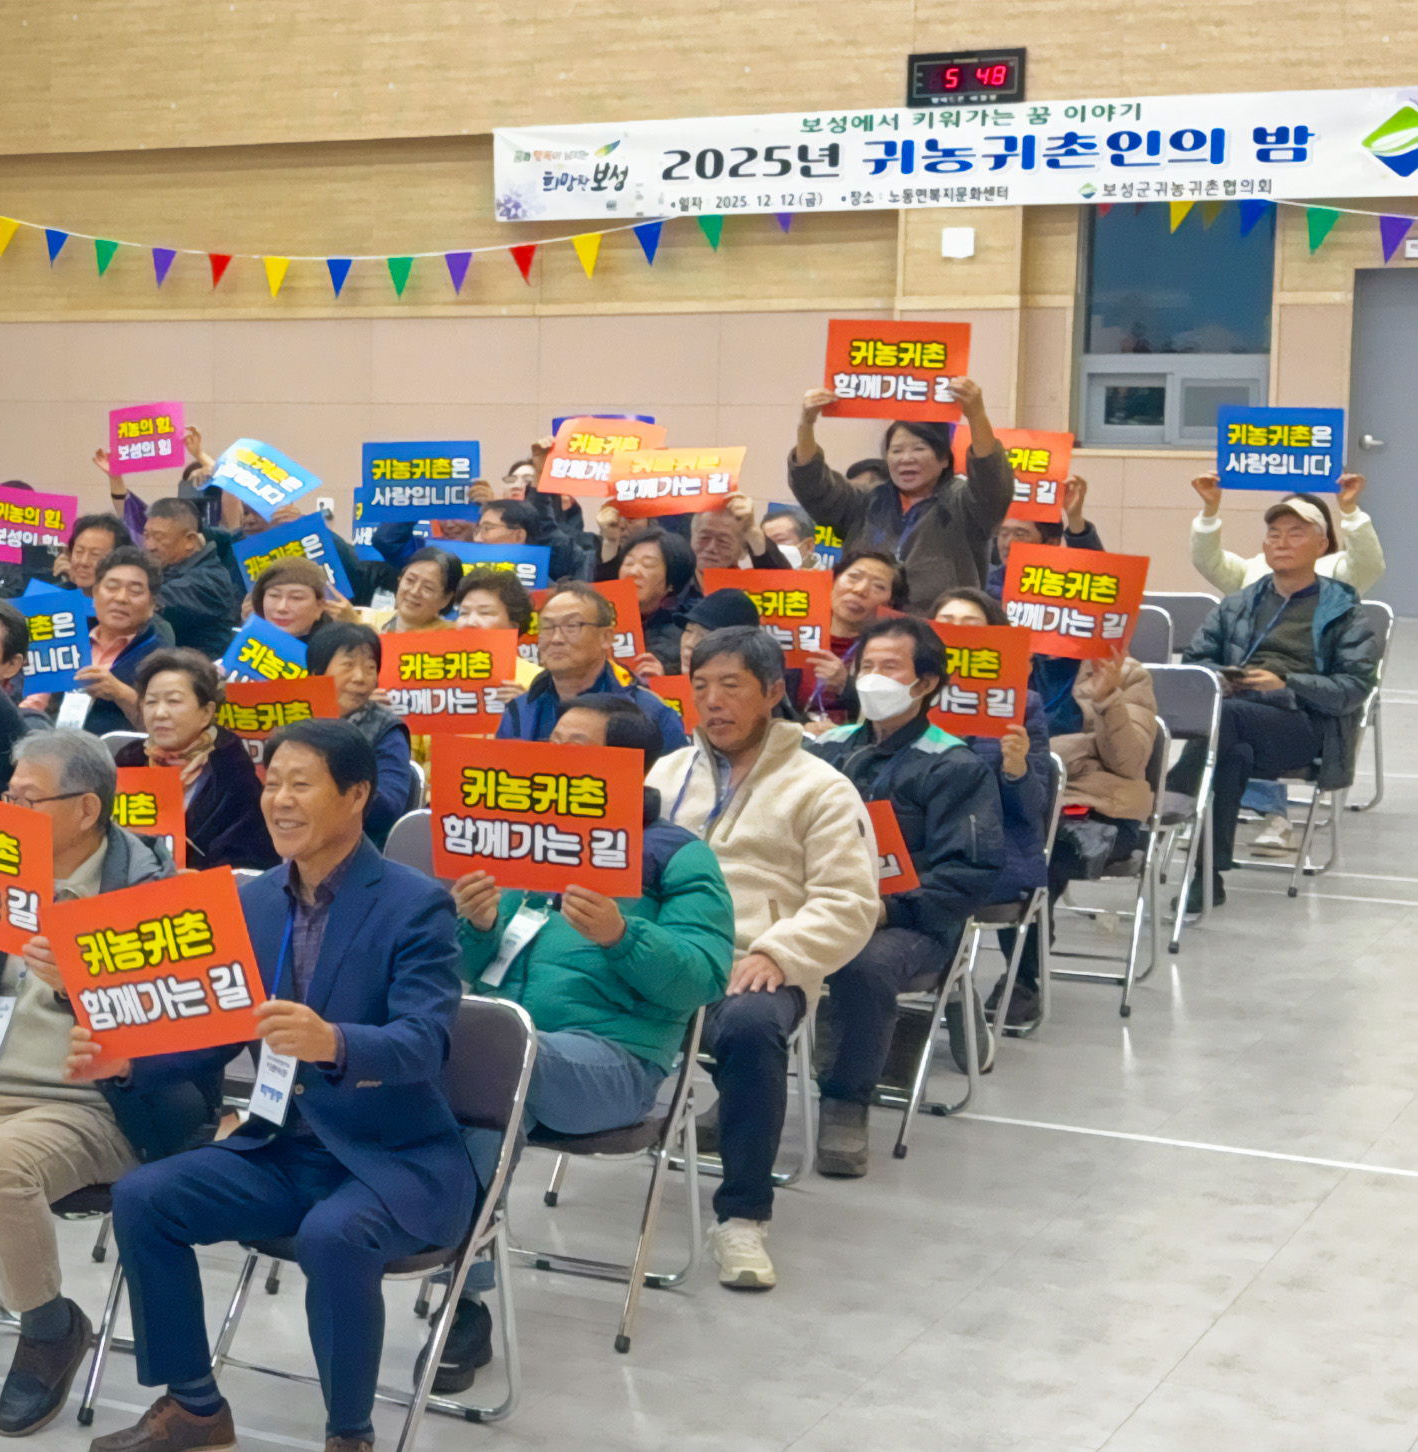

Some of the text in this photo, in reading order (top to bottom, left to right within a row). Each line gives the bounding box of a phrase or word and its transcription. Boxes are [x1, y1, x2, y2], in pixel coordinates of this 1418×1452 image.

[945, 65, 1006, 89] 5 48
[800, 102, 1143, 134] 보성에서 키워가는 꿈 이야기
[662, 124, 1316, 181] 2025년 귀농귀촌인의 밤
[591, 162, 629, 192] 보성
[1101, 178, 1273, 198] 보성군귀농귀촌협의회
[849, 340, 947, 369] 귀농귀촌
[833, 373, 928, 401] 함께가는
[117, 418, 154, 439] 귀농의
[1226, 423, 1332, 448] 귀농귀촌은
[117, 438, 172, 461] 보성의 힘
[371, 457, 471, 480] 귀농귀촌은
[1225, 453, 1332, 476] 사랑입니다
[370, 485, 470, 507] 사랑입니다
[1035, 480, 1057, 505] 길
[1019, 565, 1120, 605] 귀농귀촌
[1006, 600, 1129, 640] 함께가는 길
[612, 632, 636, 659] 길
[799, 625, 821, 651] 길
[398, 650, 493, 681] 귀농귀촌
[945, 646, 1001, 680] 귀촌
[386, 688, 479, 716] 함께가는
[986, 687, 1015, 719] 길
[461, 766, 608, 818] 귀농귀촌
[441, 813, 629, 870] 함께가는 길
[6, 887, 41, 934] 길
[76, 910, 215, 977] 귀농귀촌
[78, 961, 253, 1032] 함께가는 길
